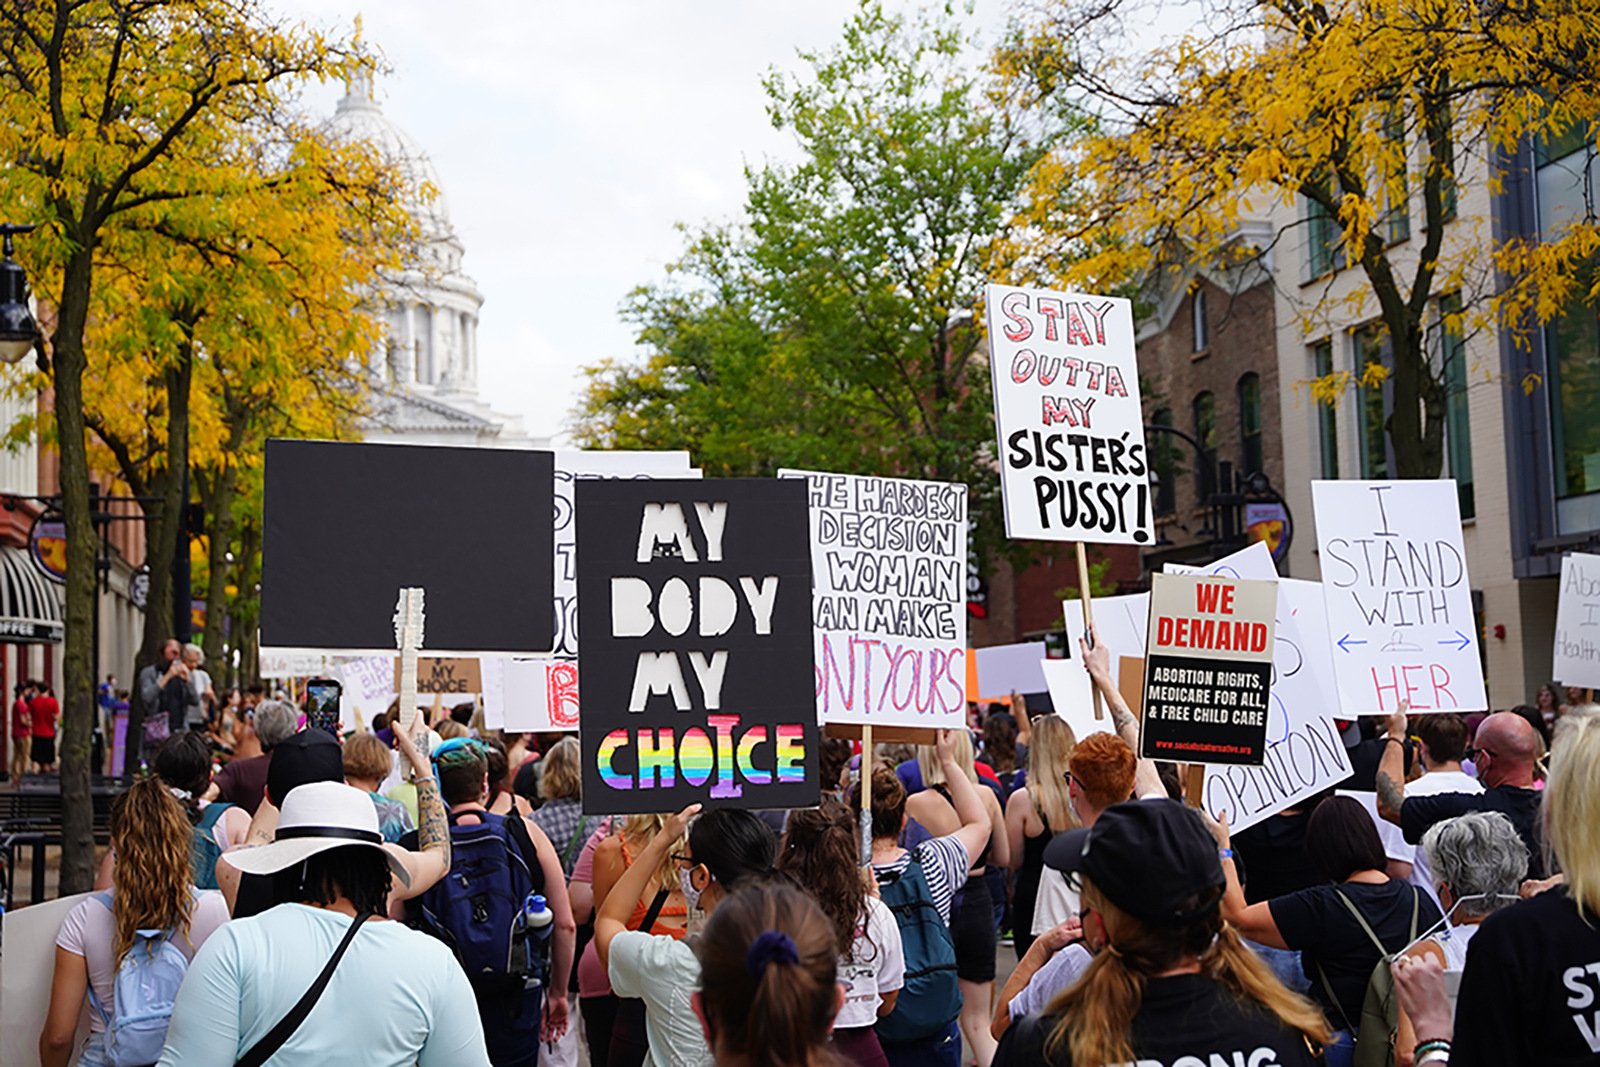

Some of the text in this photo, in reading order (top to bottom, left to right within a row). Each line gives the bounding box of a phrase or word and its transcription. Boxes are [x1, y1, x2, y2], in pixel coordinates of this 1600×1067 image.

[1001, 292, 1114, 346] STAY
[1010, 349, 1128, 397] OUTTA
[1041, 396, 1096, 428] MY
[1008, 429, 1146, 476] SISTER'S
[782, 474, 967, 523] HE HARDEST
[1034, 476, 1149, 542] PUSSY!
[1369, 486, 1399, 537] I
[636, 502, 729, 563] MY
[818, 510, 957, 556] DECISION
[826, 551, 961, 602] WOMAN
[1326, 538, 1464, 588] STAND
[610, 575, 779, 638] BODY
[814, 597, 957, 640] AN MAKE
[1196, 582, 1236, 615] WE
[1352, 590, 1450, 627] WITH
[1156, 616, 1268, 653] DEMAND
[431, 664, 456, 680] MY
[628, 651, 729, 712] MY
[877, 643, 965, 714] YOURS
[1148, 684, 1211, 705] MEDICARE
[1214, 689, 1238, 706] FOR
[1153, 667, 1214, 687] ABORTION
[1371, 663, 1458, 711] HER
[1148, 704, 1265, 726] & FREE CHILD CARE
[596, 713, 806, 800] CHOICE
[1207, 715, 1346, 826] OPINION
